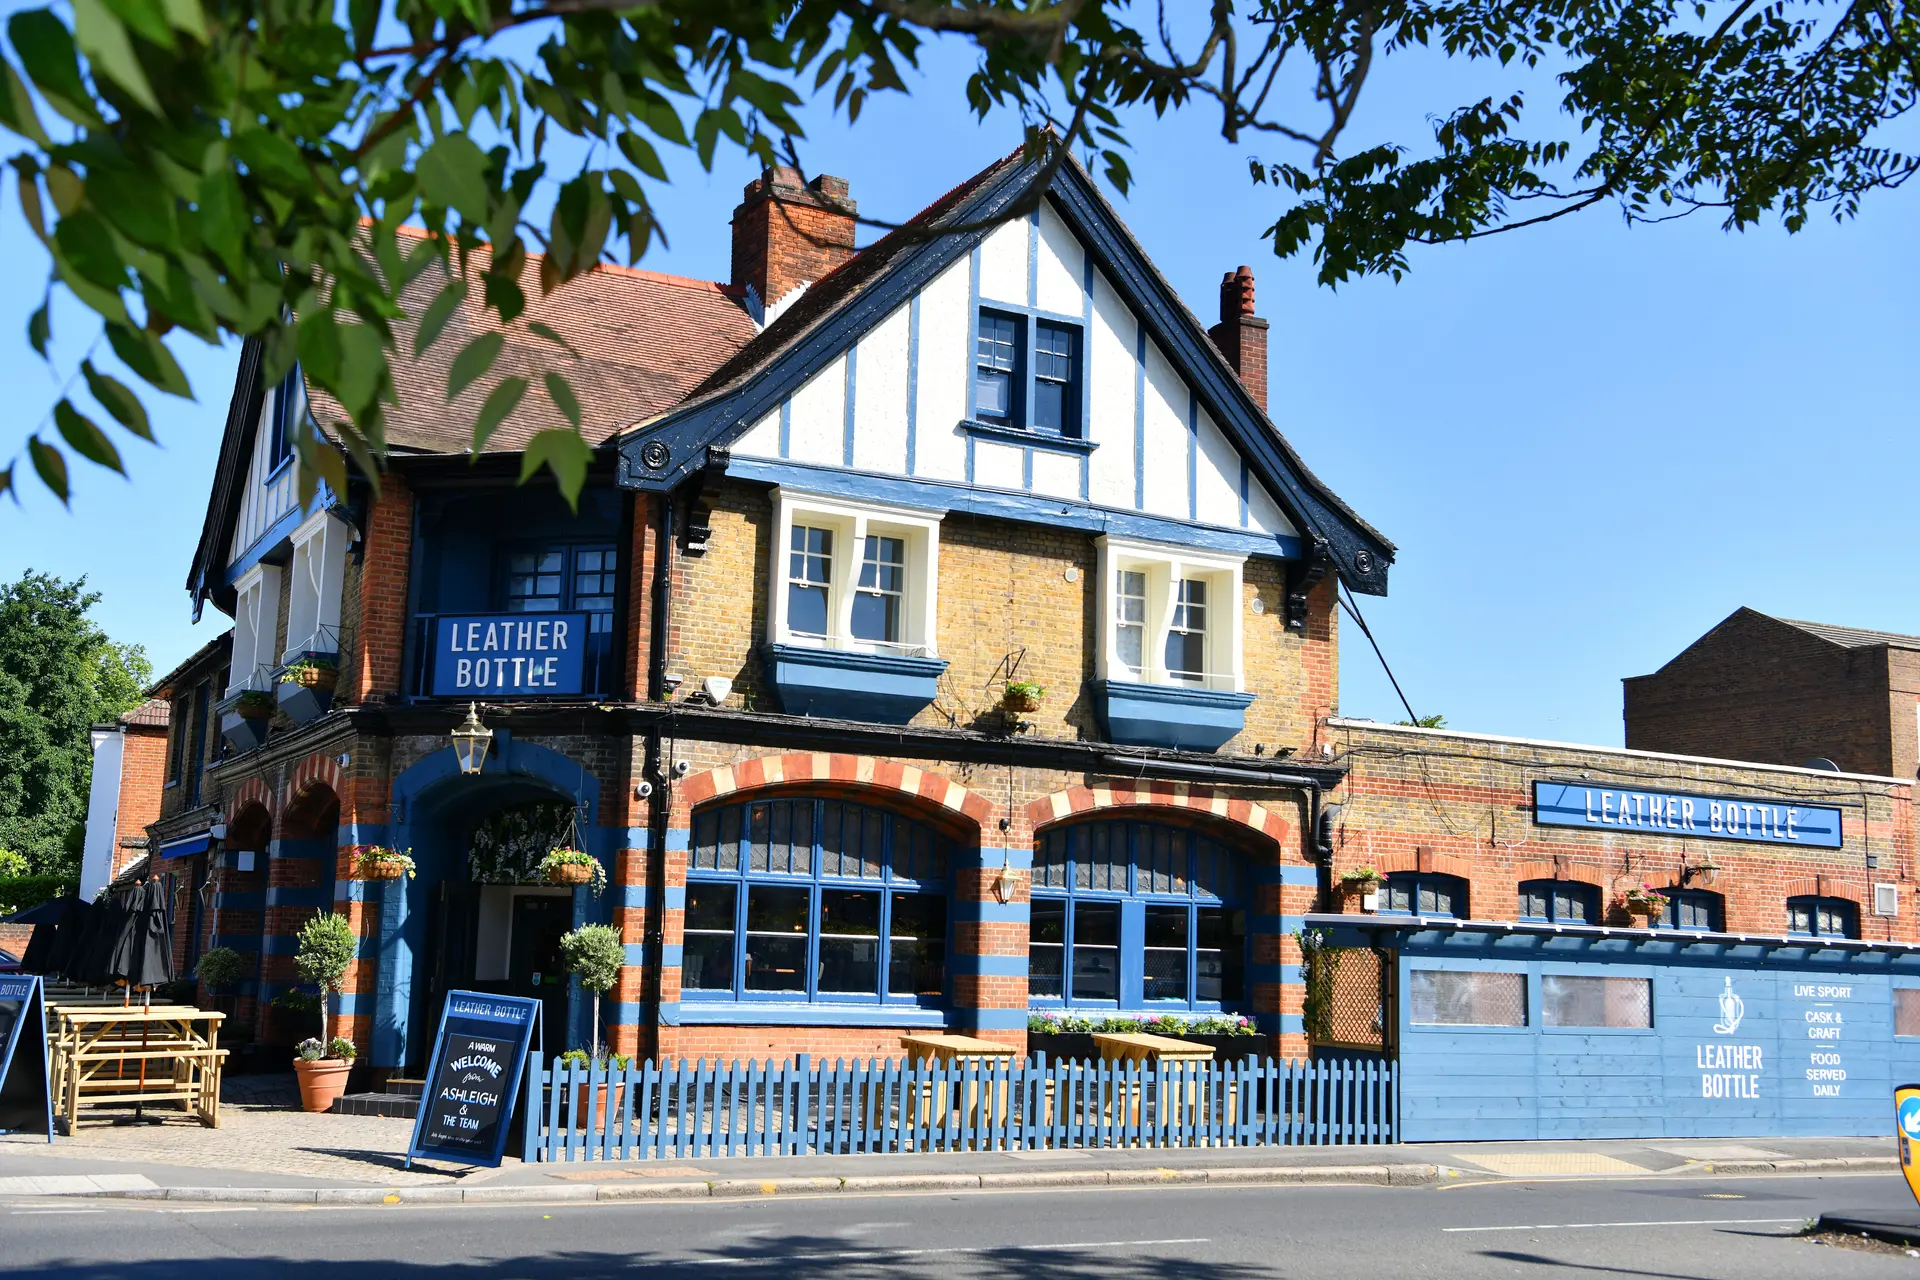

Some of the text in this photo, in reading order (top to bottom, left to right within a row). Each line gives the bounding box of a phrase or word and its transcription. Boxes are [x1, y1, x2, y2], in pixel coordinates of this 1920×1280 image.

[451, 620, 569, 652] LEATHER
[456, 656, 559, 688] BOTTLE
[1585, 790, 1799, 839] LEATHER BOTTLE
[0, 985, 27, 996] BOTTLE
[1794, 985, 1852, 998] LIVE SPORT
[454, 1001, 527, 1020] LEATHER BOTTLE
[1805, 1011, 1842, 1023] CASK &
[1808, 1027, 1841, 1039] CRAFT
[468, 1041, 496, 1053] A WARM
[1697, 1045, 1763, 1070] LEATHER
[1811, 1053, 1841, 1065] FOOD
[450, 1054, 503, 1079] WELCOME
[462, 1072, 484, 1084] from
[1806, 1069, 1847, 1081] SERVED
[1702, 1074, 1760, 1098] BOTTLE
[1813, 1085, 1841, 1096] DAILY
[440, 1087, 498, 1107] ASHLEIGH
[459, 1104, 468, 1116] &
[442, 1114, 480, 1130] THE TEAM
